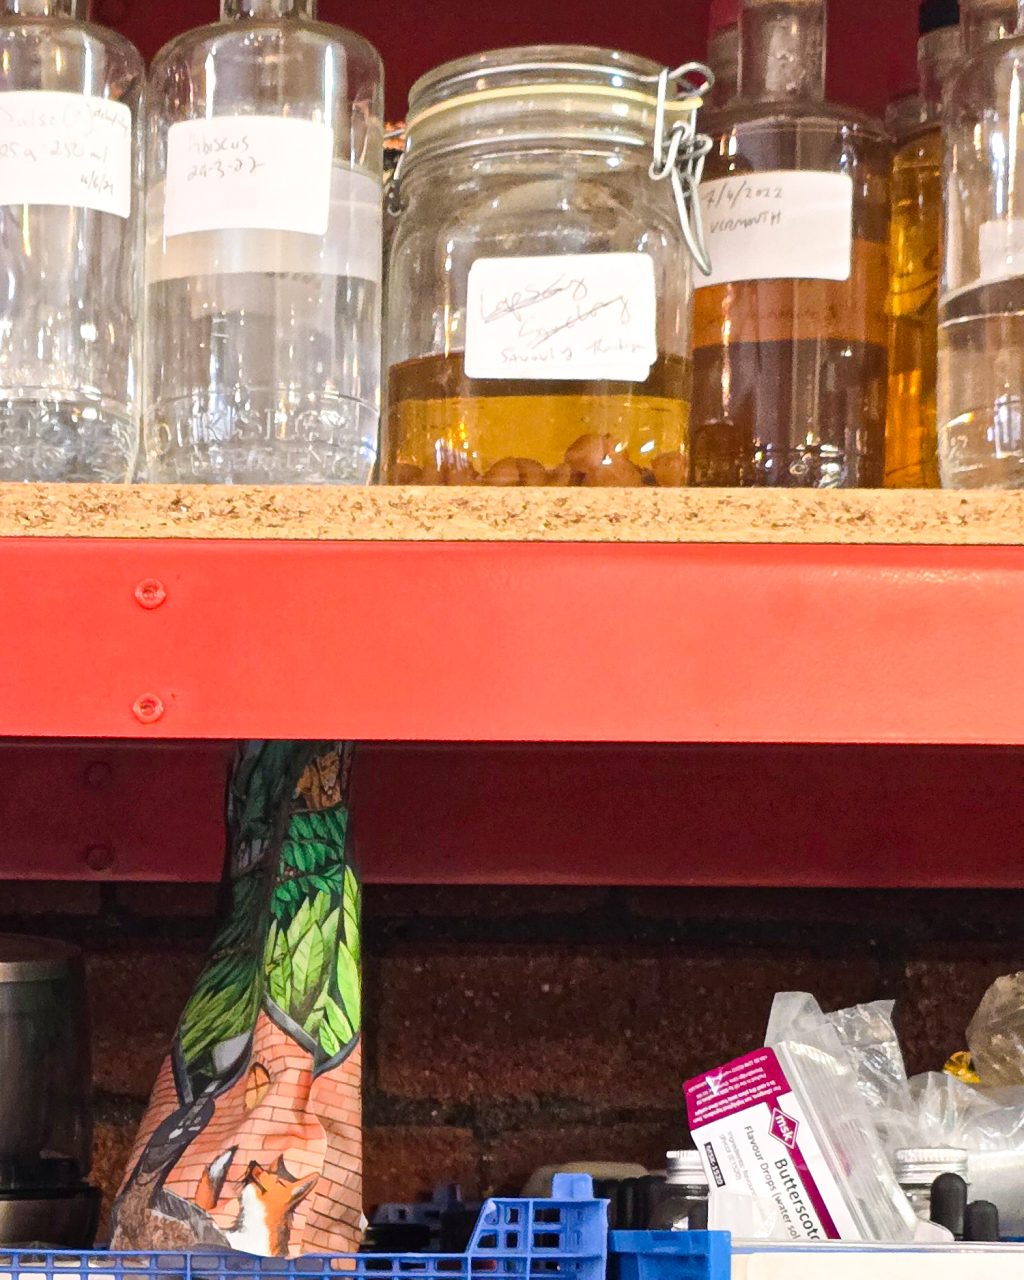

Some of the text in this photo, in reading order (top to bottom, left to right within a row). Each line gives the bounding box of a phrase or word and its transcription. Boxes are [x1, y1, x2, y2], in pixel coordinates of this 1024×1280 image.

[775, 1114, 794, 1141] msk
[744, 1125, 764, 1162] Flavour
[760, 1162, 777, 1192] Drops
